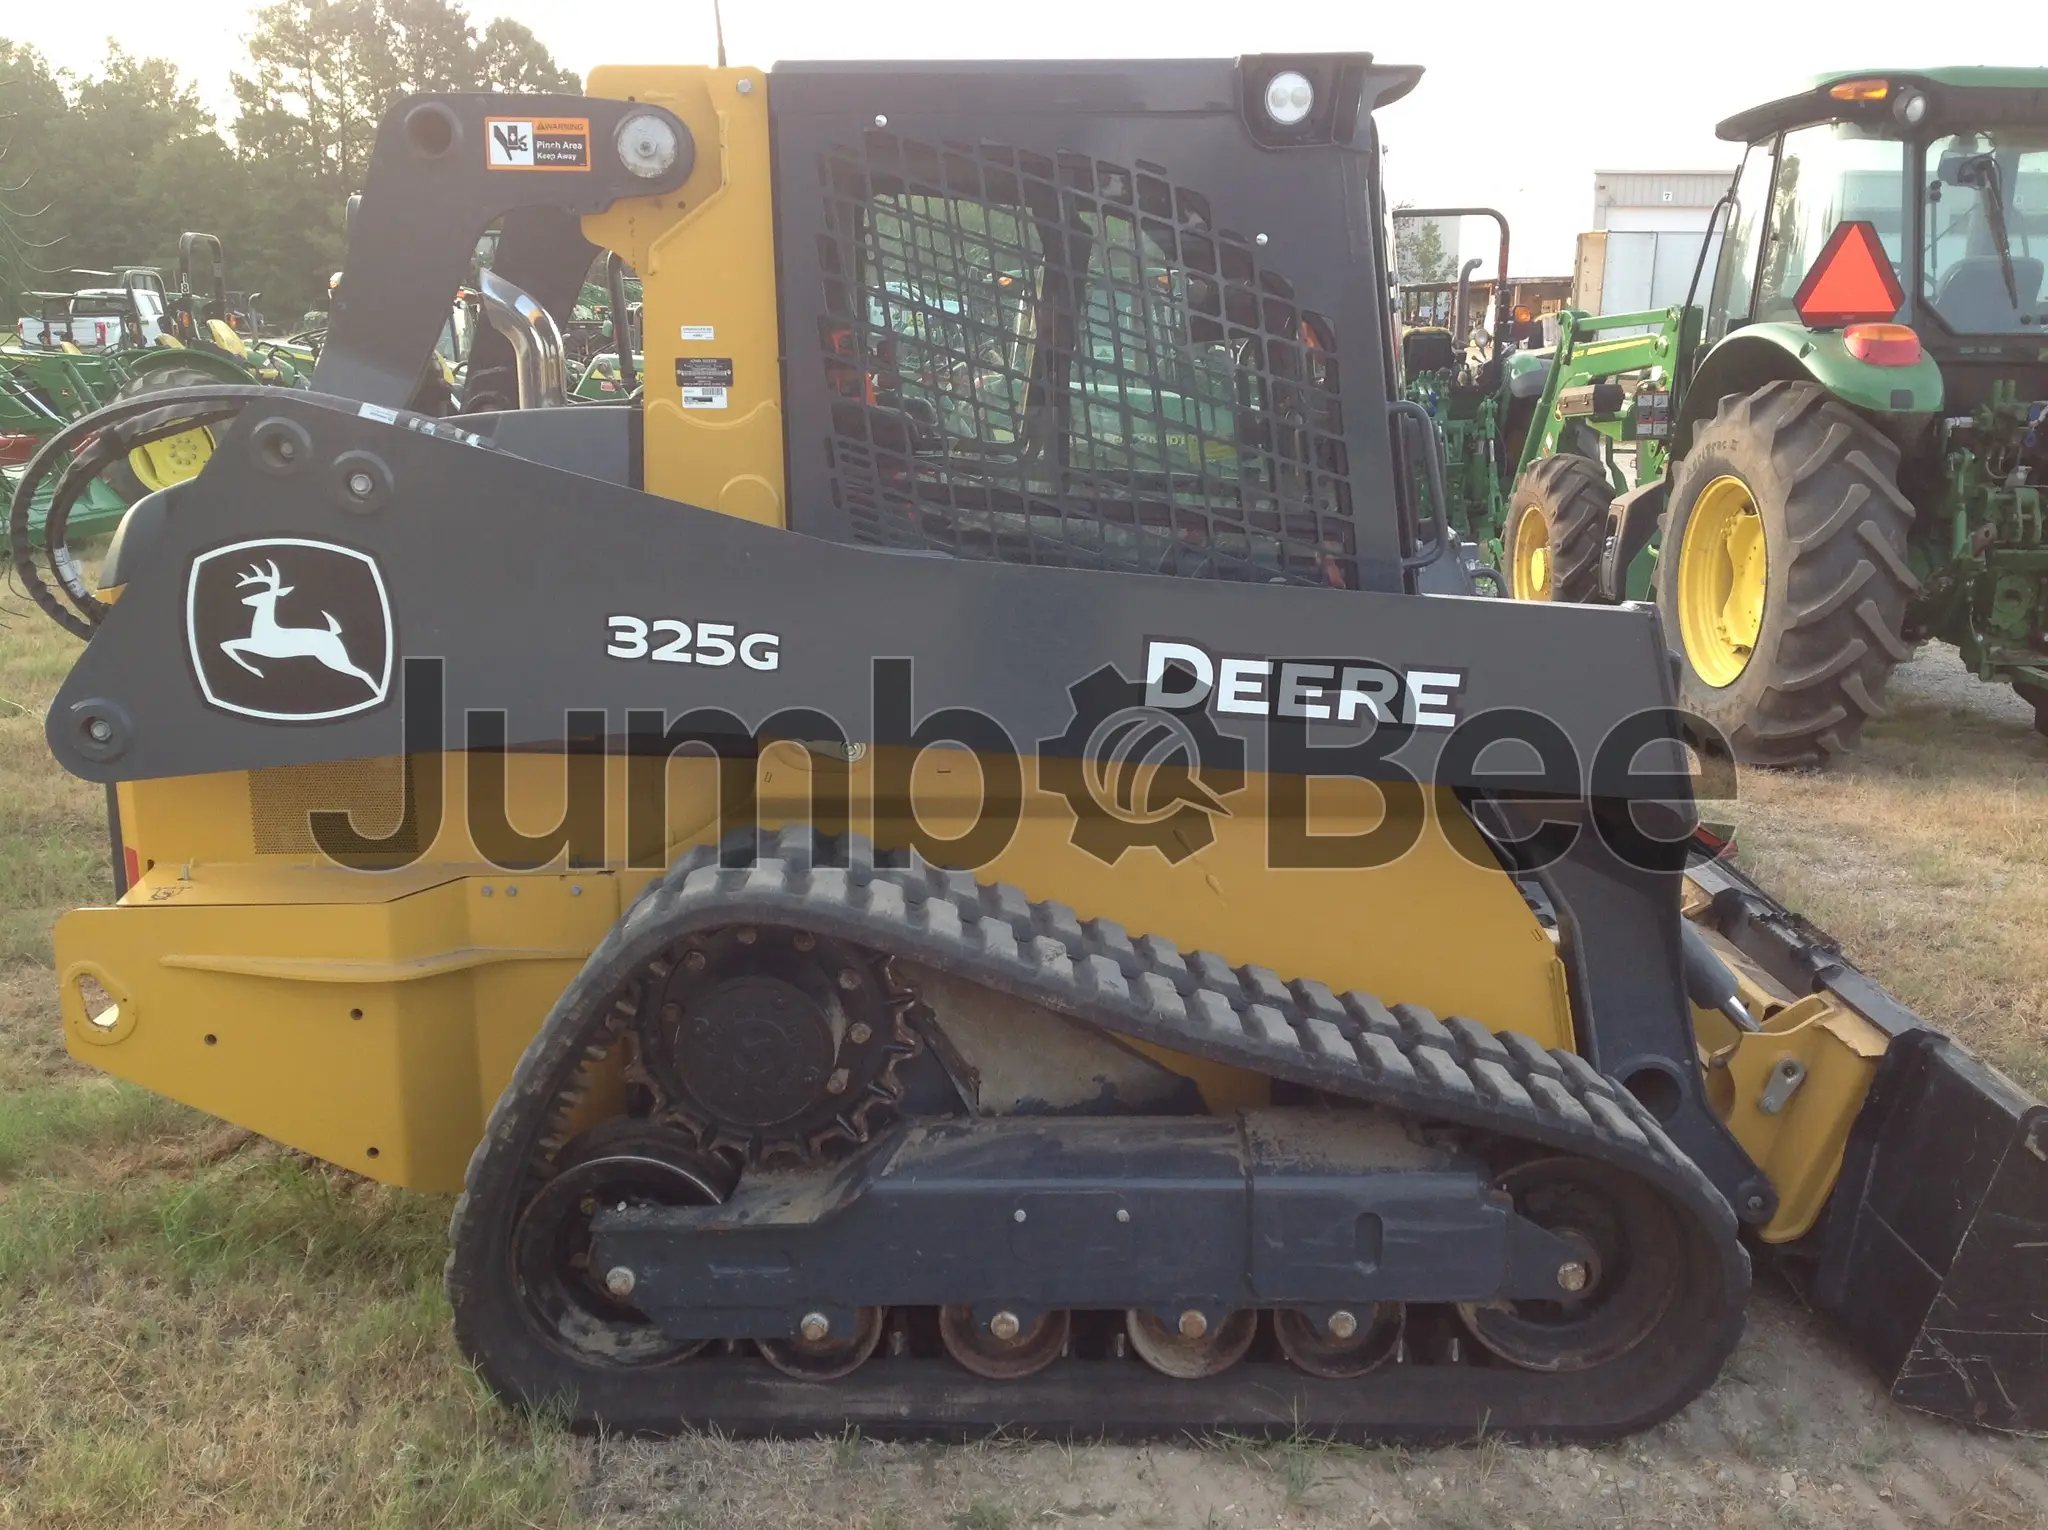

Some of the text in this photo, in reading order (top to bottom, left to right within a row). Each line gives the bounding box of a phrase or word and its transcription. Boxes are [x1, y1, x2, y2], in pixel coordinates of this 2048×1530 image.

[544, 123, 583, 131] WARNING
[537, 141, 583, 150] Pinch Area
[537, 152, 577, 162] Keep Away
[607, 616, 779, 670] 325G
[1145, 641, 1461, 727] DEERE
